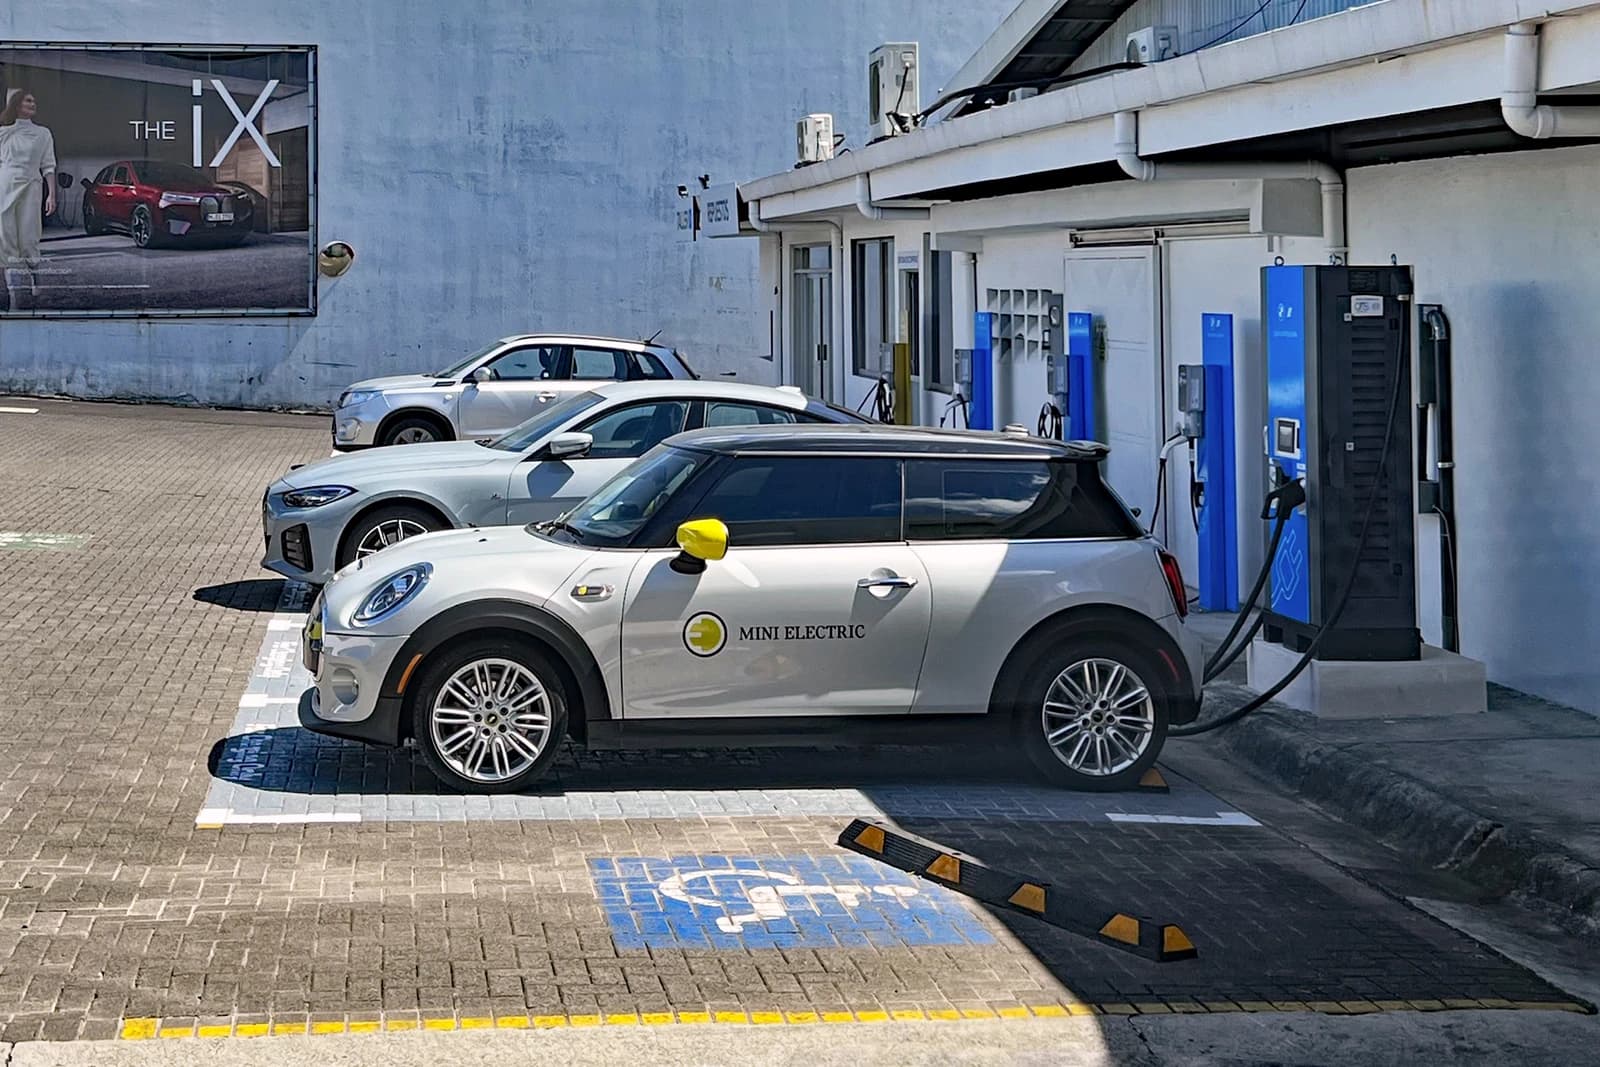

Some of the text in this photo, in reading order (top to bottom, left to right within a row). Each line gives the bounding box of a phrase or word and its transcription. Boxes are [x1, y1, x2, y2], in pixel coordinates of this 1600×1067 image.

[129, 79, 281, 168] THE iX
[739, 624, 866, 641] MINI ELECTRIC
